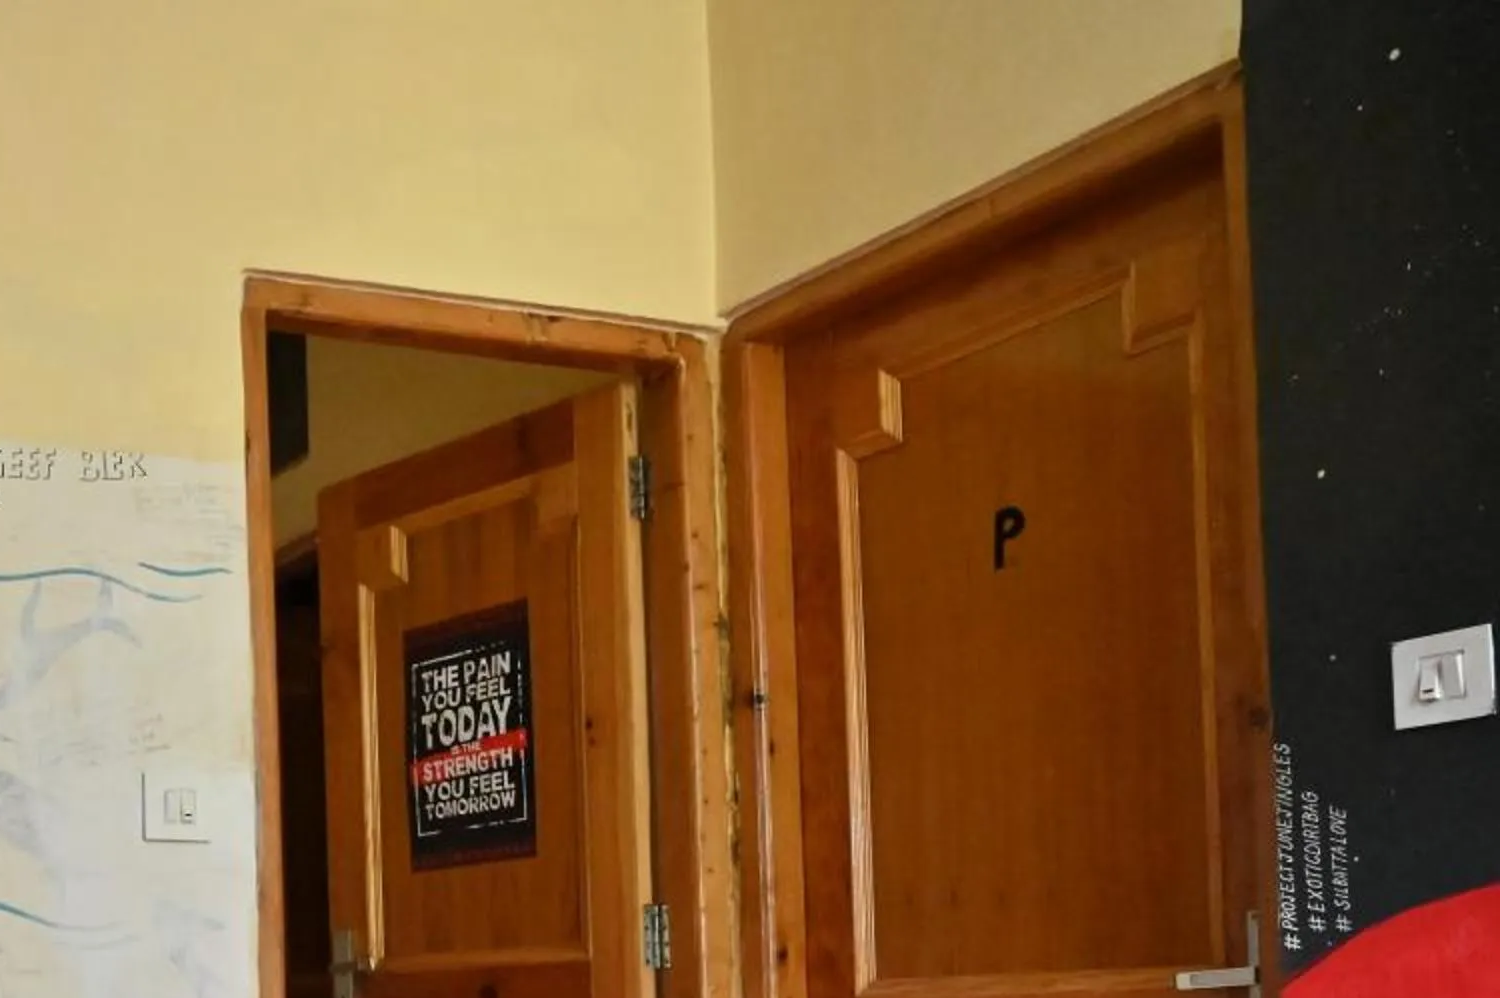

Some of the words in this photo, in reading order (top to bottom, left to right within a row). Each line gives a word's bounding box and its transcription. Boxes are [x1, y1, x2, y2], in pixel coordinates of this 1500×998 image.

[993, 504, 1027, 572] P
[420, 664, 460, 693] THE
[463, 650, 512, 685] PAIN
[421, 688, 460, 713] YOU
[464, 675, 512, 703] FEEL
[420, 695, 512, 750] TODAY
[422, 745, 514, 783] STRENGTH
[424, 777, 466, 803] YOU
[468, 769, 516, 797] FEEL
[424, 789, 517, 821] TOMORROW
